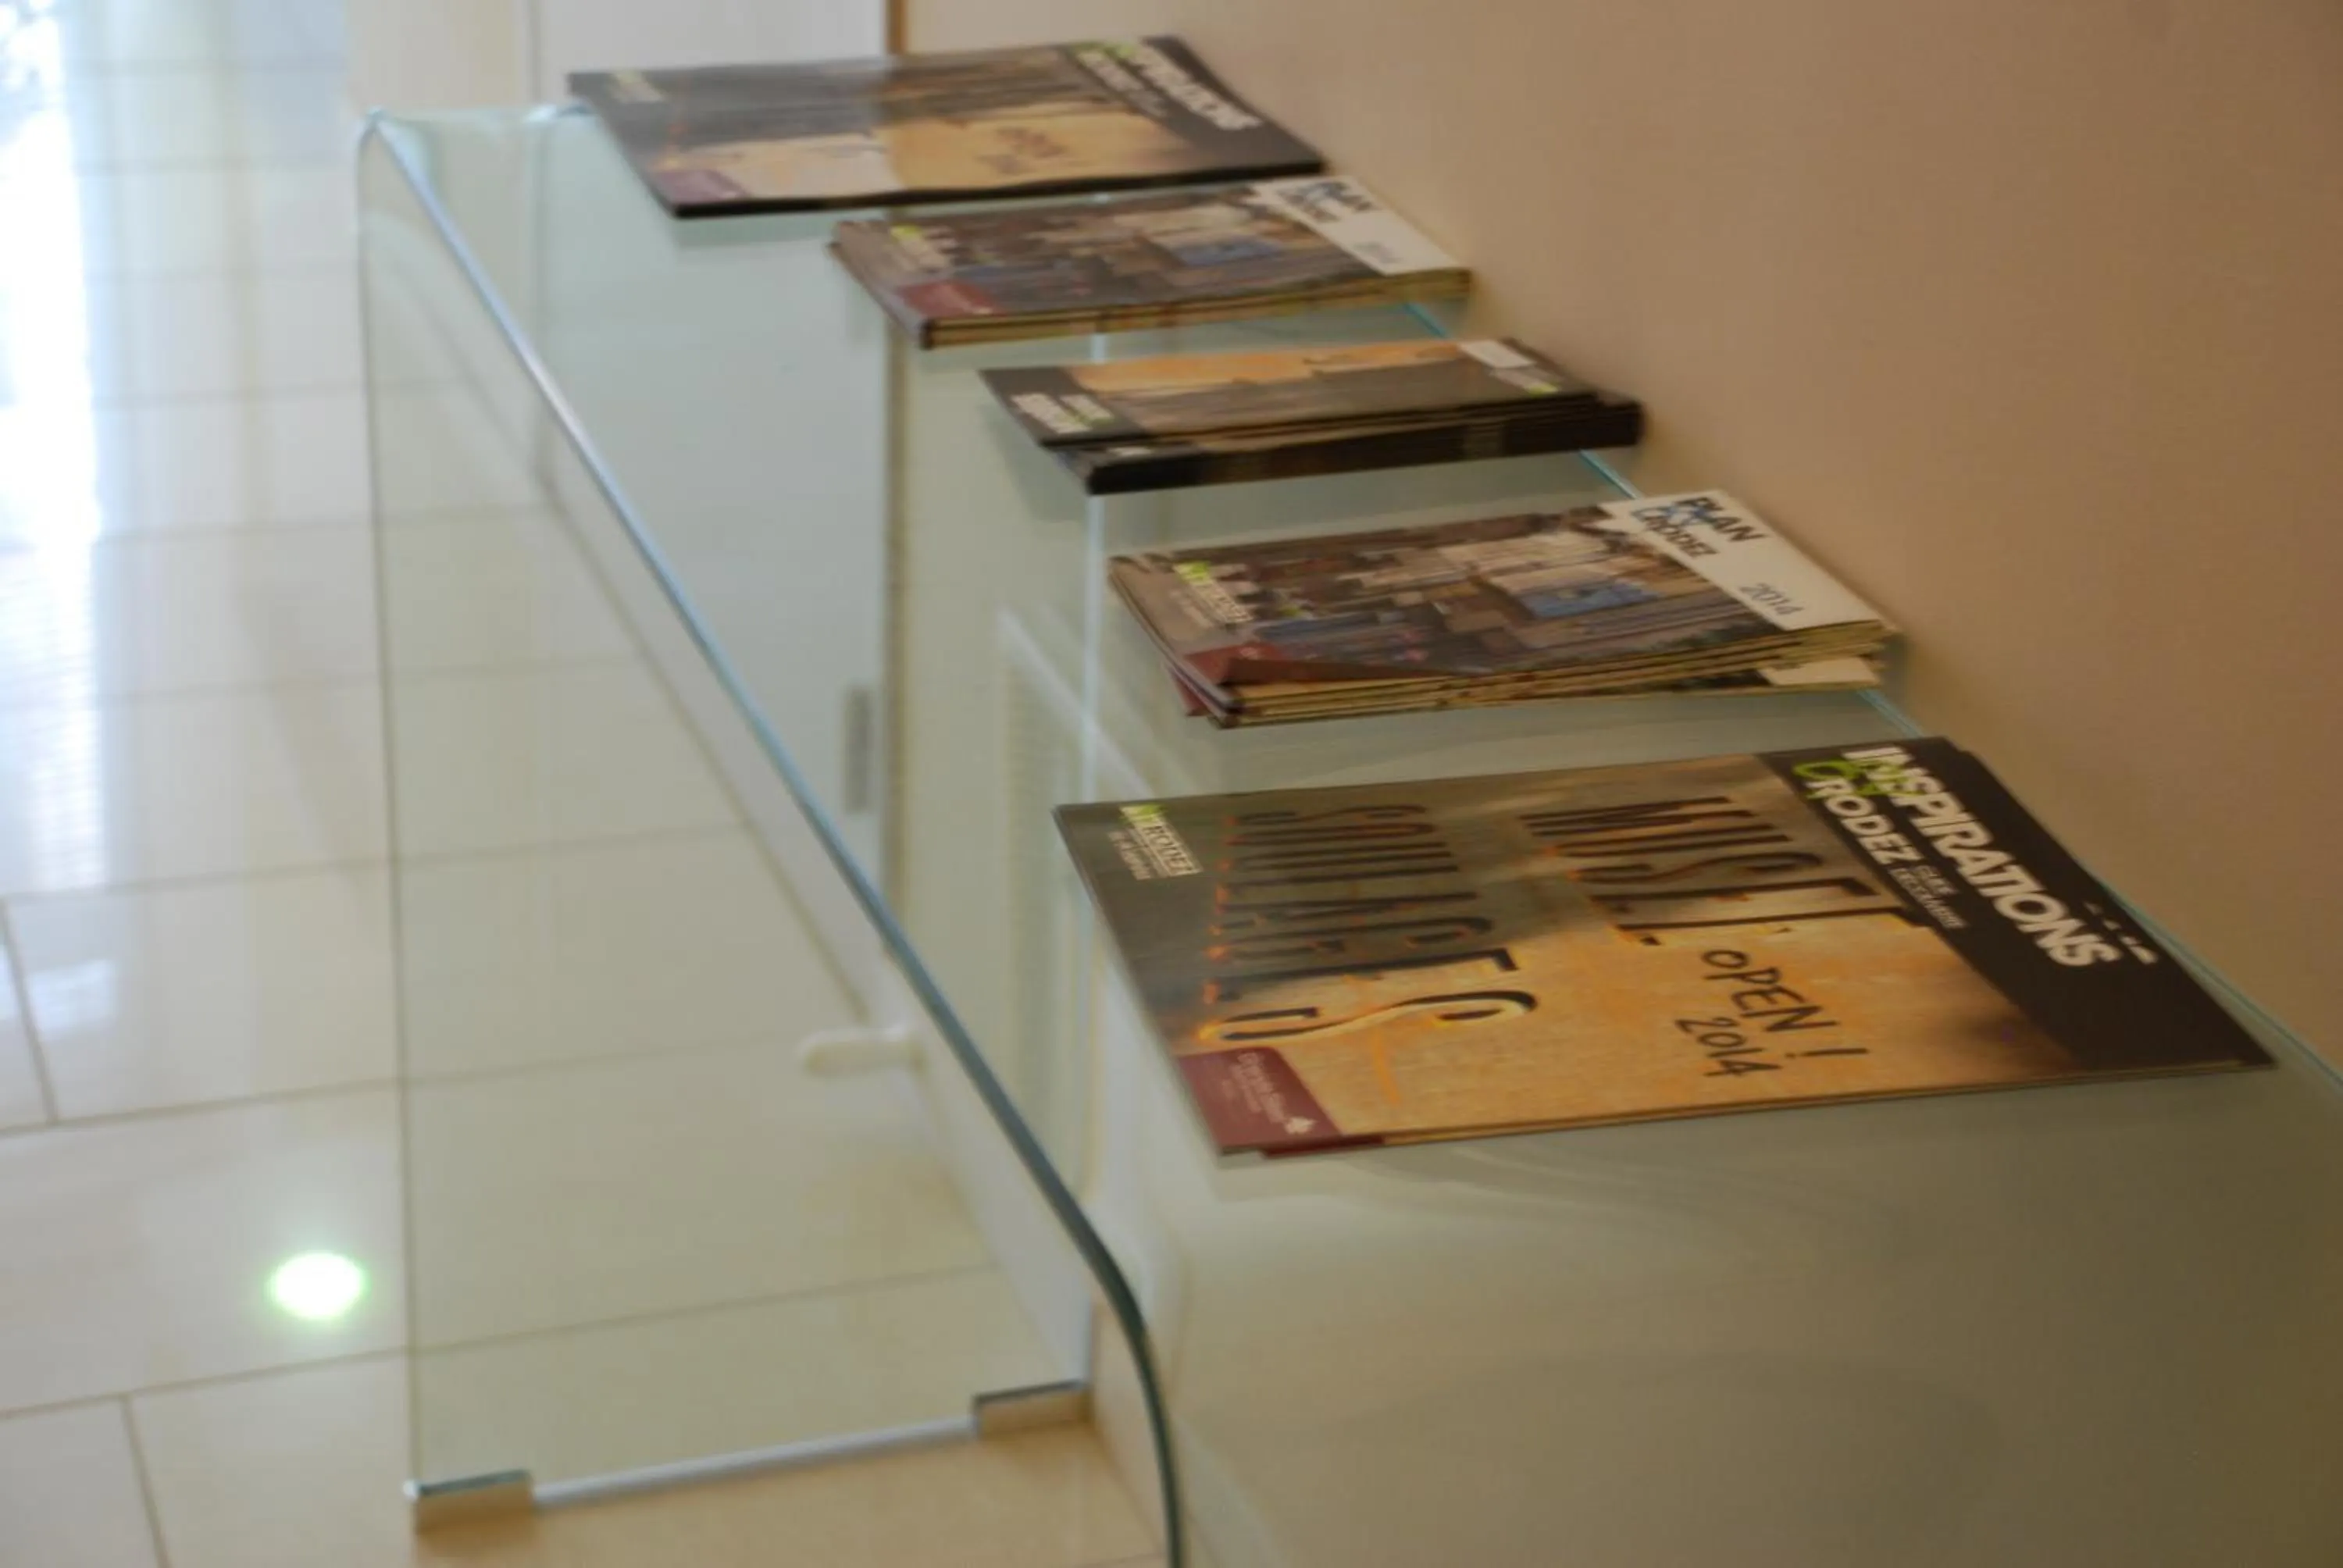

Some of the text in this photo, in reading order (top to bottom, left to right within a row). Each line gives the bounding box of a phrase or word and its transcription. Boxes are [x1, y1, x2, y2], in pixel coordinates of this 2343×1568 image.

[1674, 496, 1767, 543] PLAN
[1805, 779, 1923, 866] RODEZ
[1842, 746, 2120, 967] INSPIRATIONS
[1674, 1017, 1782, 1078] 2014
